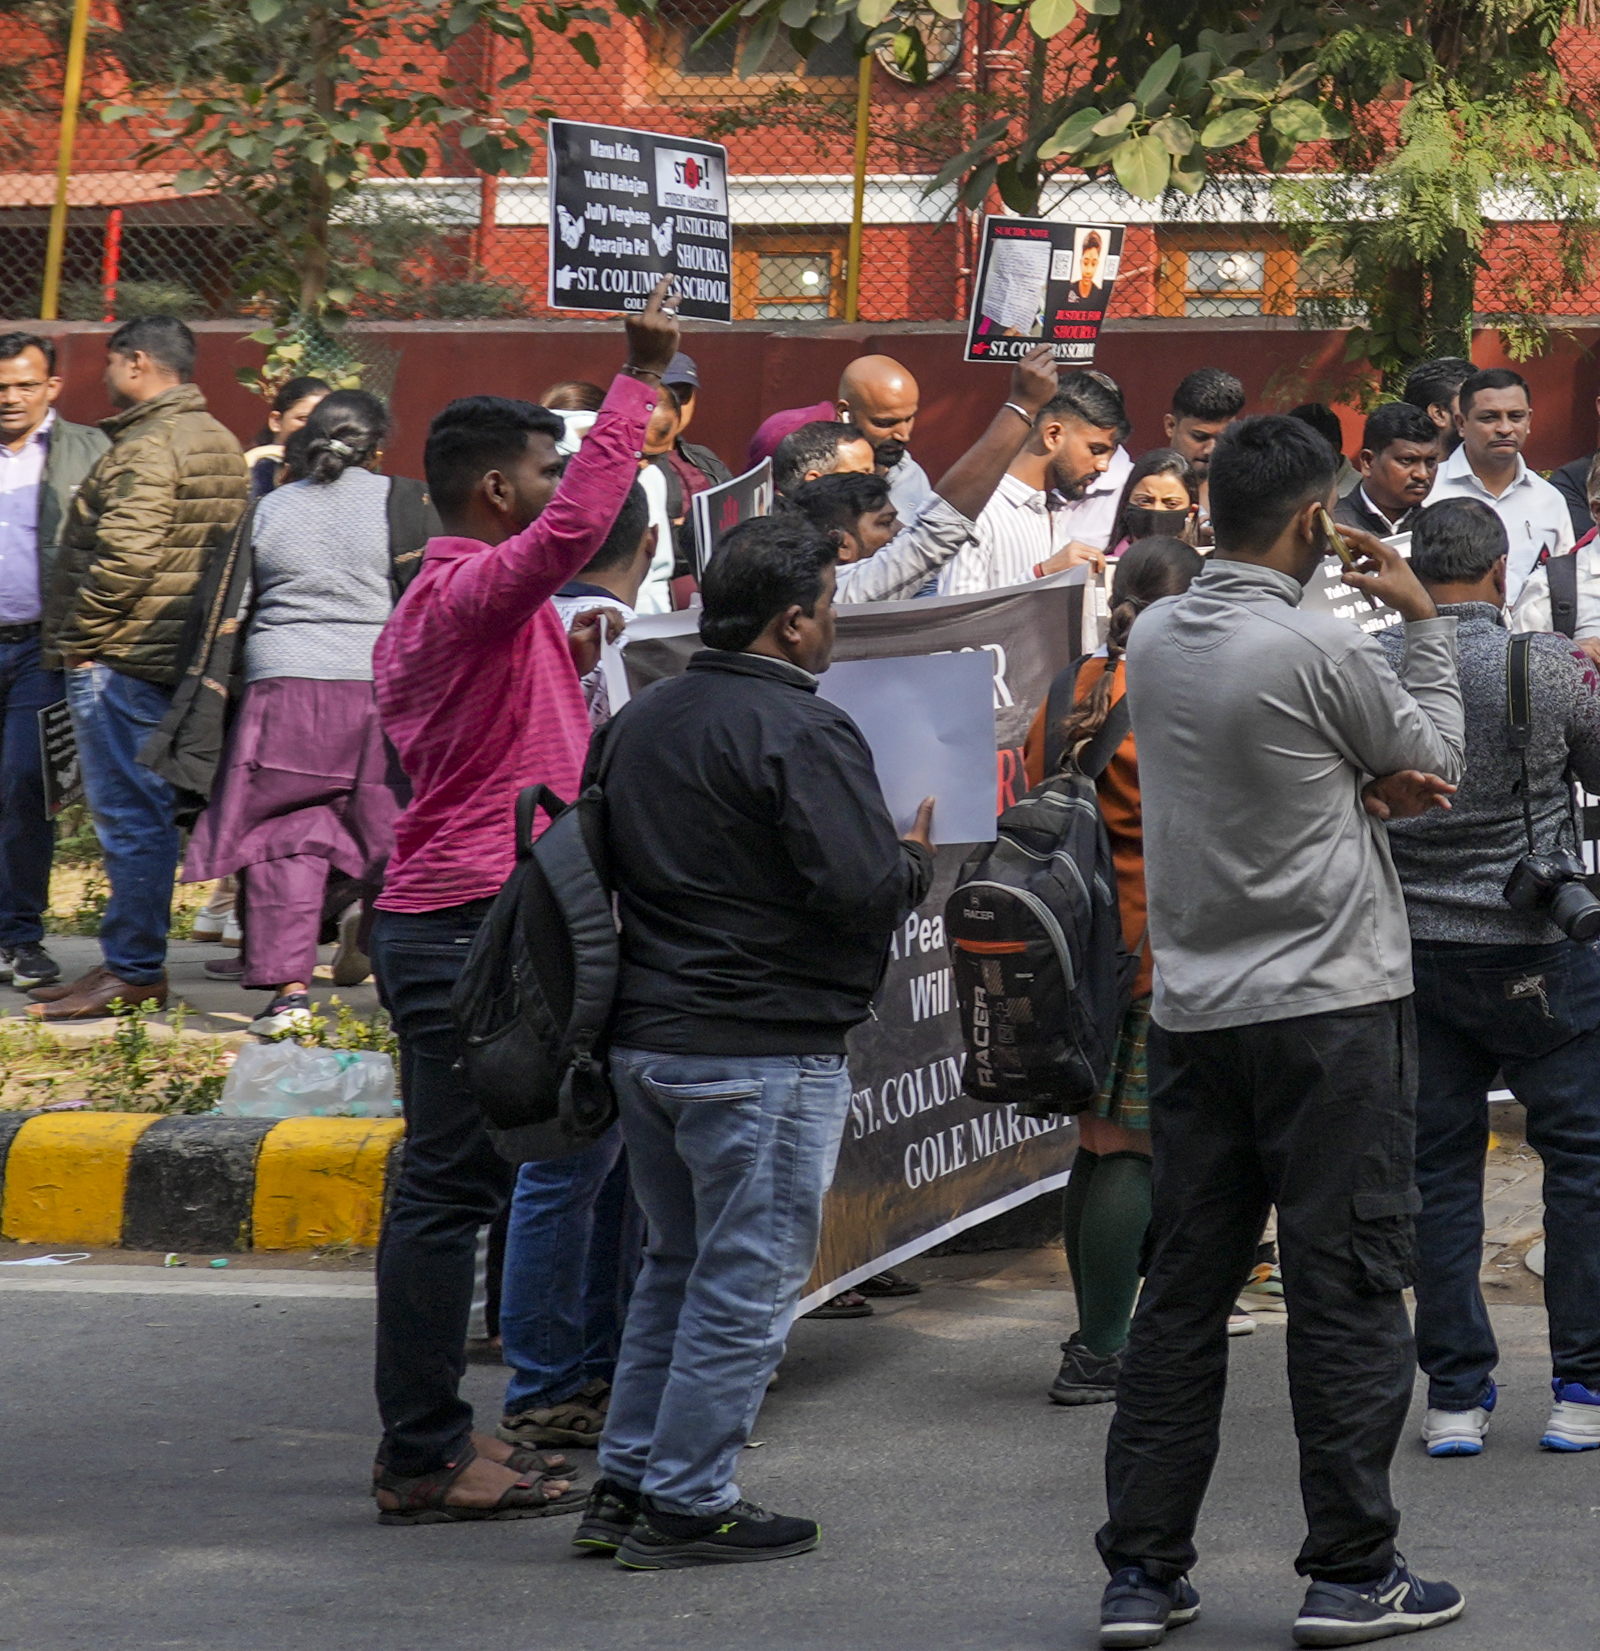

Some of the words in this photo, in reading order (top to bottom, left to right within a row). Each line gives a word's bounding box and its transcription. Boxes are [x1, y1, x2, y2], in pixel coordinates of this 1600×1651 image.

[590, 139, 614, 160] Manu
[676, 215, 707, 236] JUSTICE
[707, 219, 728, 240] FOR
[677, 243, 728, 274] SHOURYA
[577, 267, 599, 291] ST.
[682, 275, 729, 304] SCHOOL
[989, 340, 1008, 357] ST.
[963, 909, 995, 921] RACER
[909, 968, 949, 1023] Will
[972, 985, 998, 1089] RACER
[852, 1087, 881, 1140] ST.
[904, 1123, 966, 1189] GOLE
